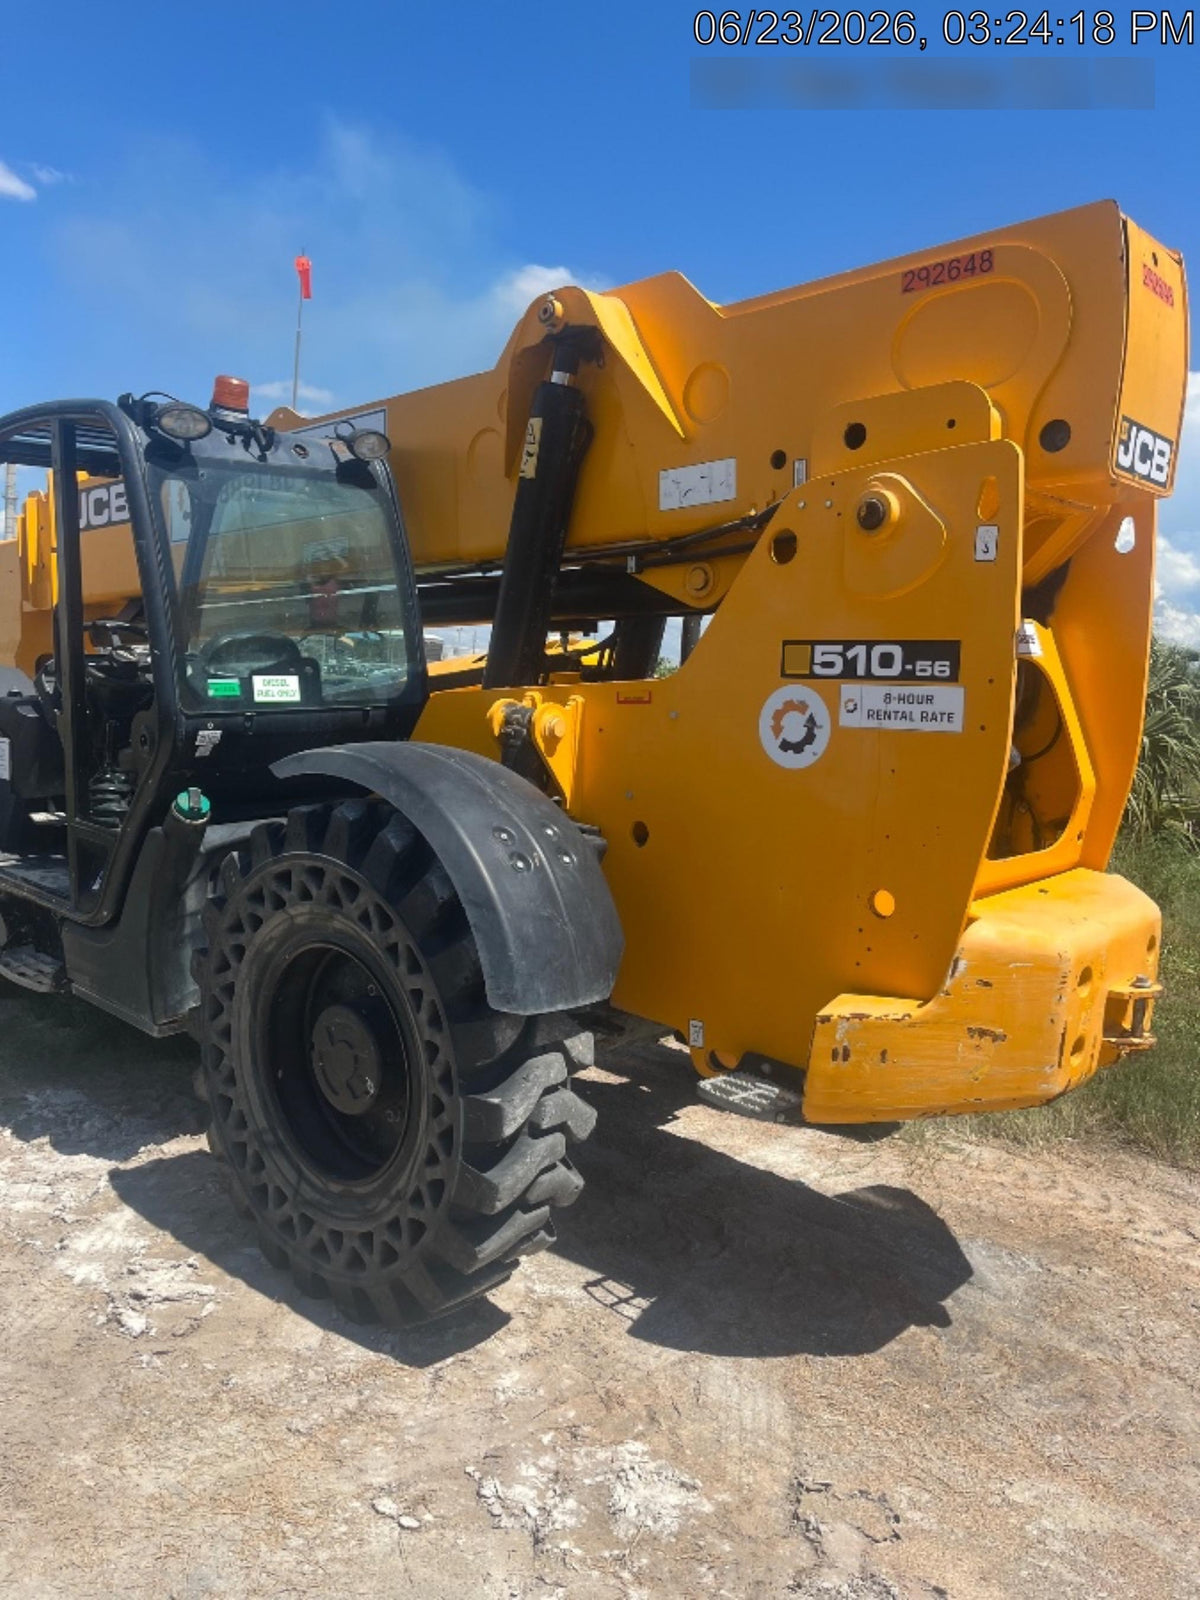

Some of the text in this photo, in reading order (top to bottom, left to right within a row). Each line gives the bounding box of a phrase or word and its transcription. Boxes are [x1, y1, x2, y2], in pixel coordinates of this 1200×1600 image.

[902, 250, 993, 293] 292648
[1118, 425, 1171, 482] JCB
[812, 644, 951, 676] 510-56
[882, 692, 935, 705] 8-HOUR
[866, 708, 955, 724] RENTAL RATE
